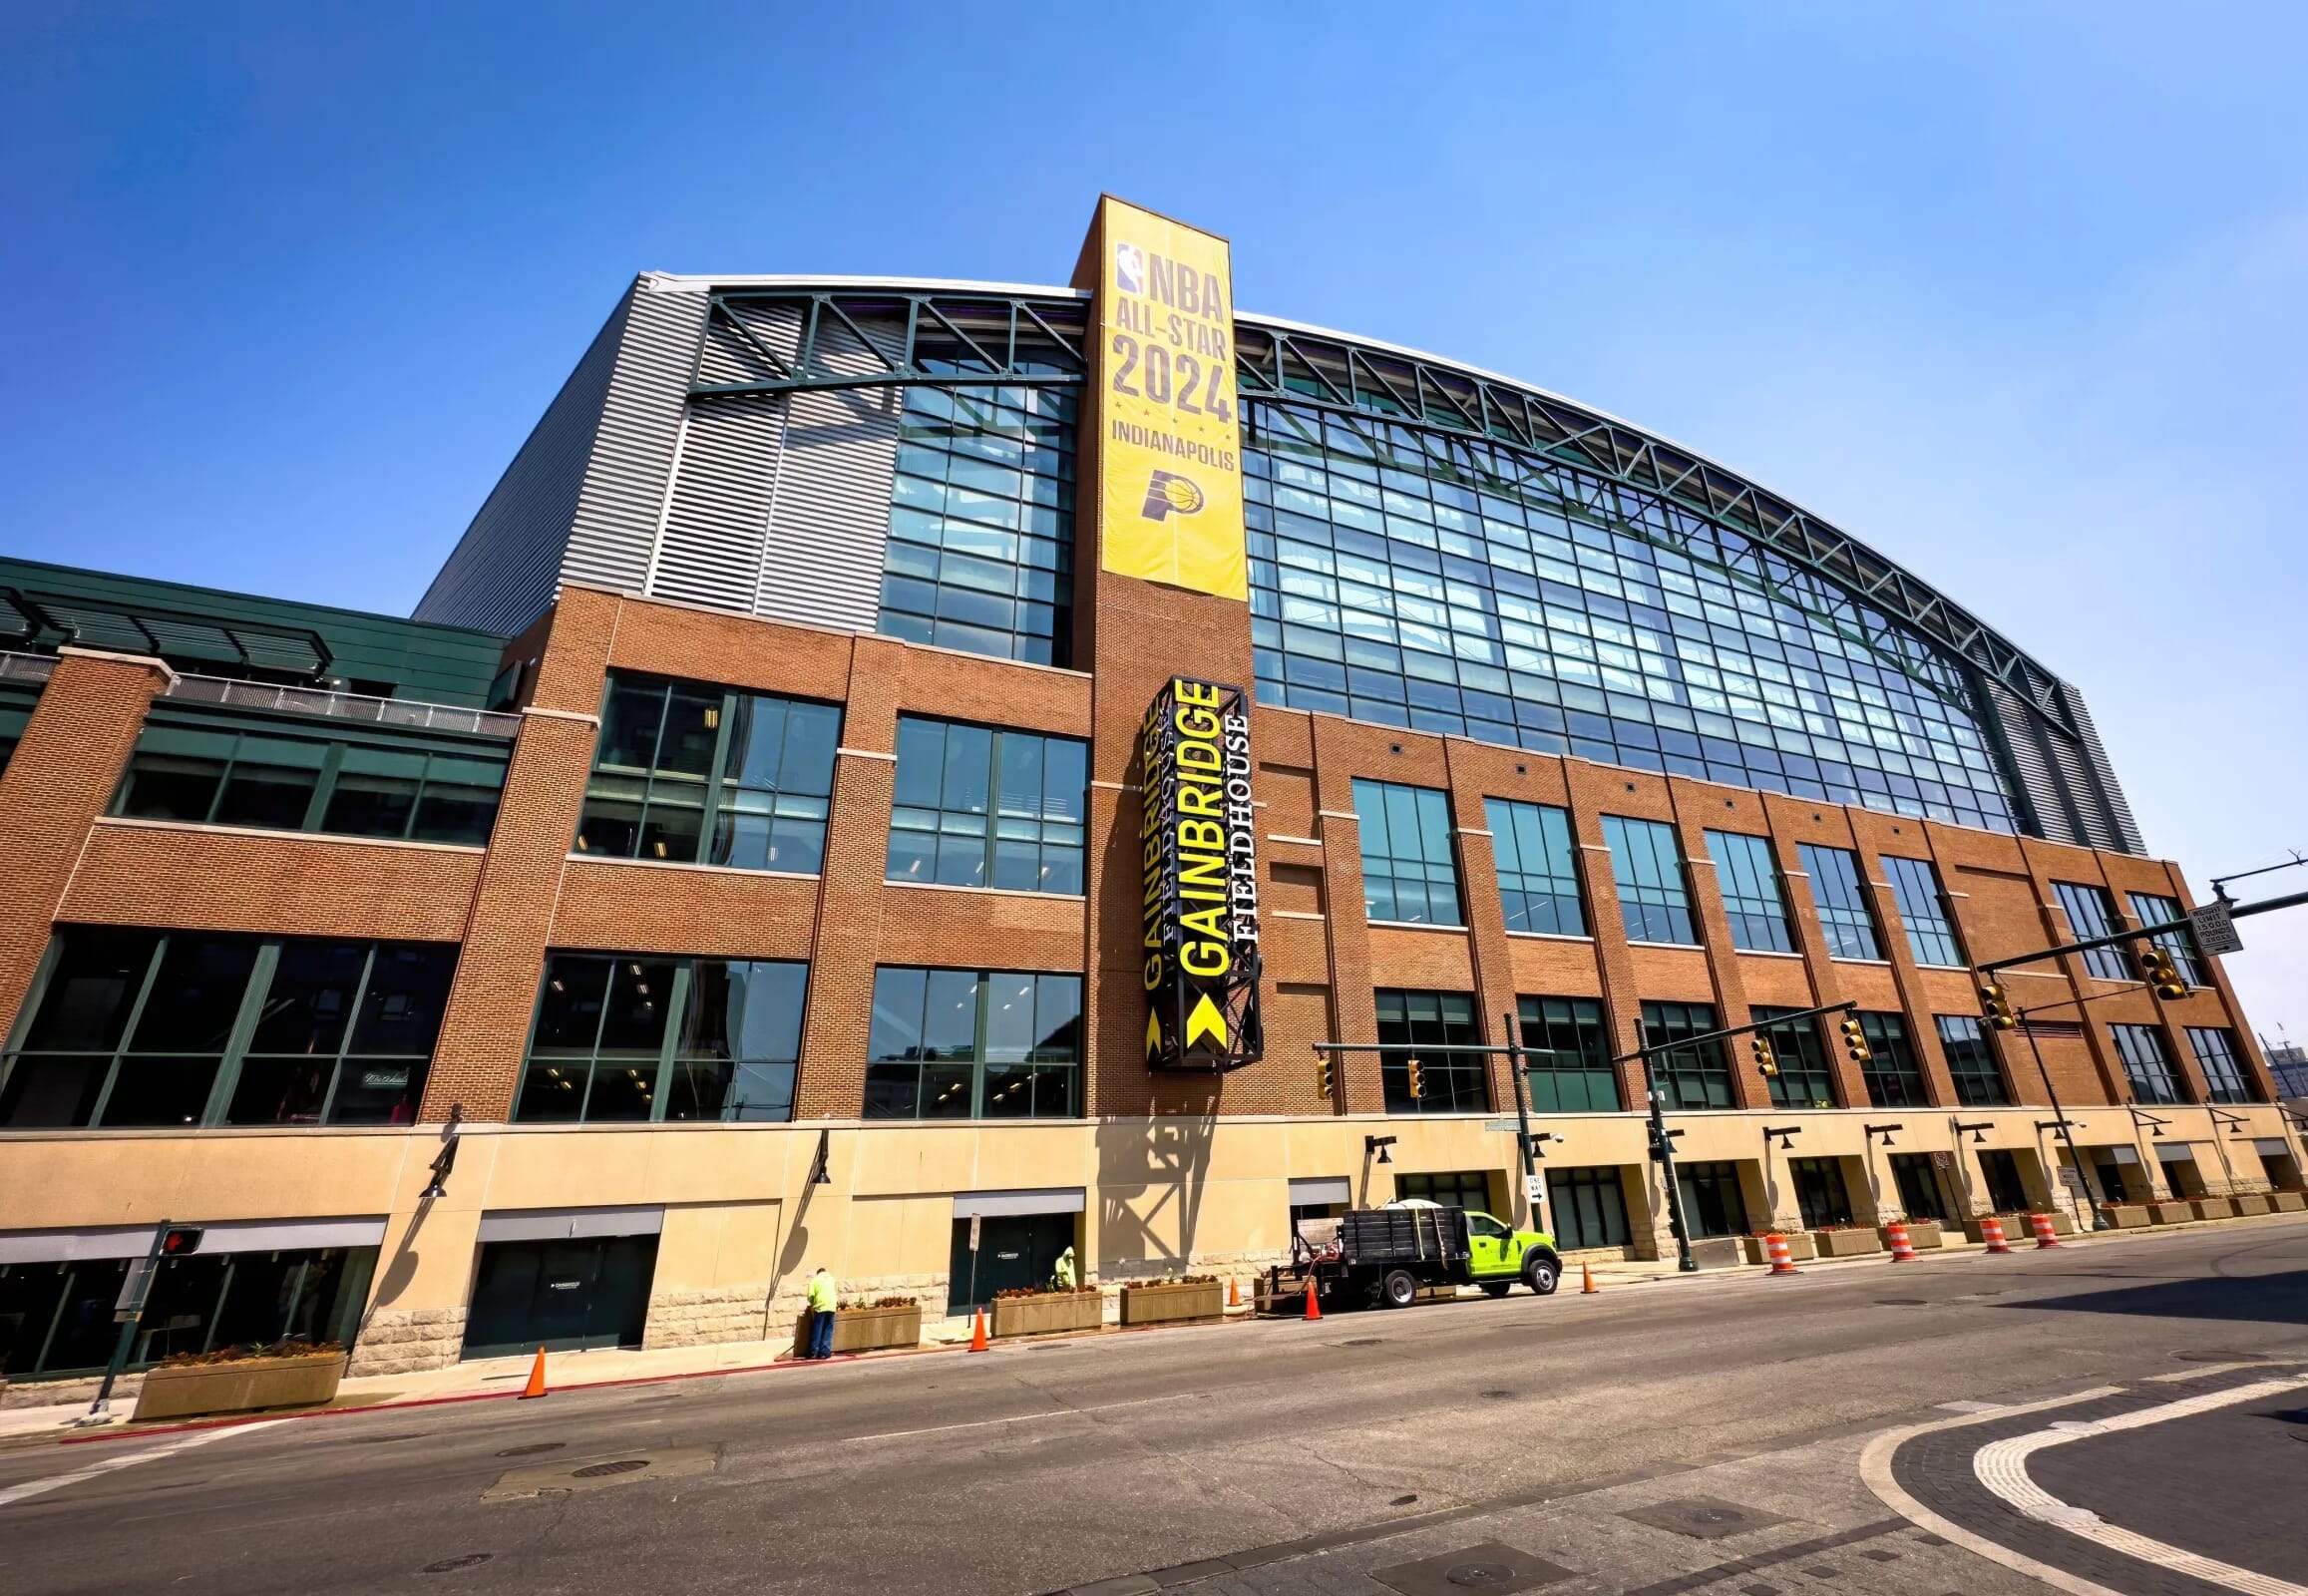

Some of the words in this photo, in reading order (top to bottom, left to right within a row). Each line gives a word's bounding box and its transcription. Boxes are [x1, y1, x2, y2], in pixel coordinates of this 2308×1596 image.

[1149, 253, 1224, 324] NBA
[1116, 296, 1226, 361] ALL-STAR
[1112, 334, 1232, 424] 2024
[1112, 420, 1235, 472] INDIANAPOLIS
[1143, 695, 1163, 992] GAINBRIDGE
[1175, 678, 1230, 978] GAINBRIDGE
[1225, 713, 1258, 944] FIELDHOUSE
[2197, 914, 2221, 924] LIMIT
[2199, 926, 2232, 939] POUNDS
